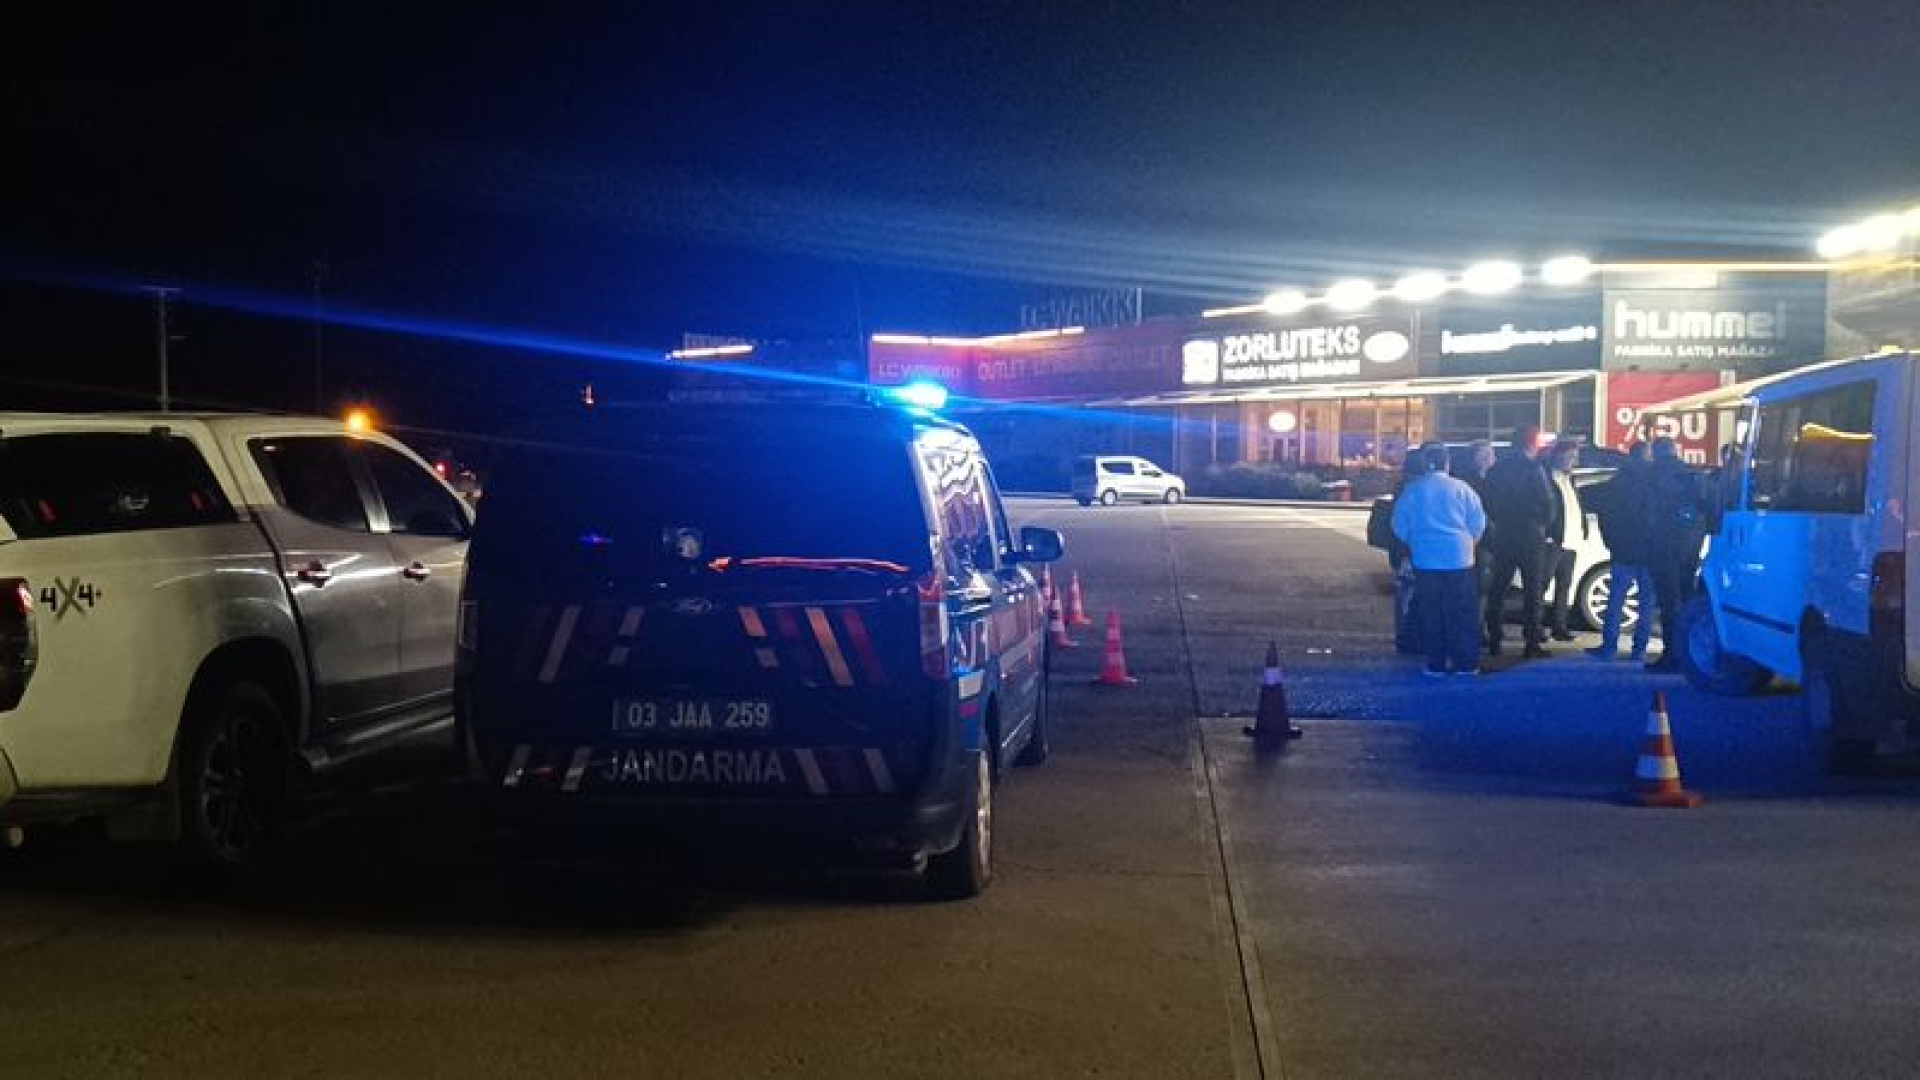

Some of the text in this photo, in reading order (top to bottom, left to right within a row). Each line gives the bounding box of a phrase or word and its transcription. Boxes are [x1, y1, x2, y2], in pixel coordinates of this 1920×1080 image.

[1614, 298, 1787, 339] hummel
[1223, 325, 1360, 363] ZORLUTEKS
[628, 701, 770, 729] 03 JAA 259
[602, 748, 787, 784] JANDARMA
